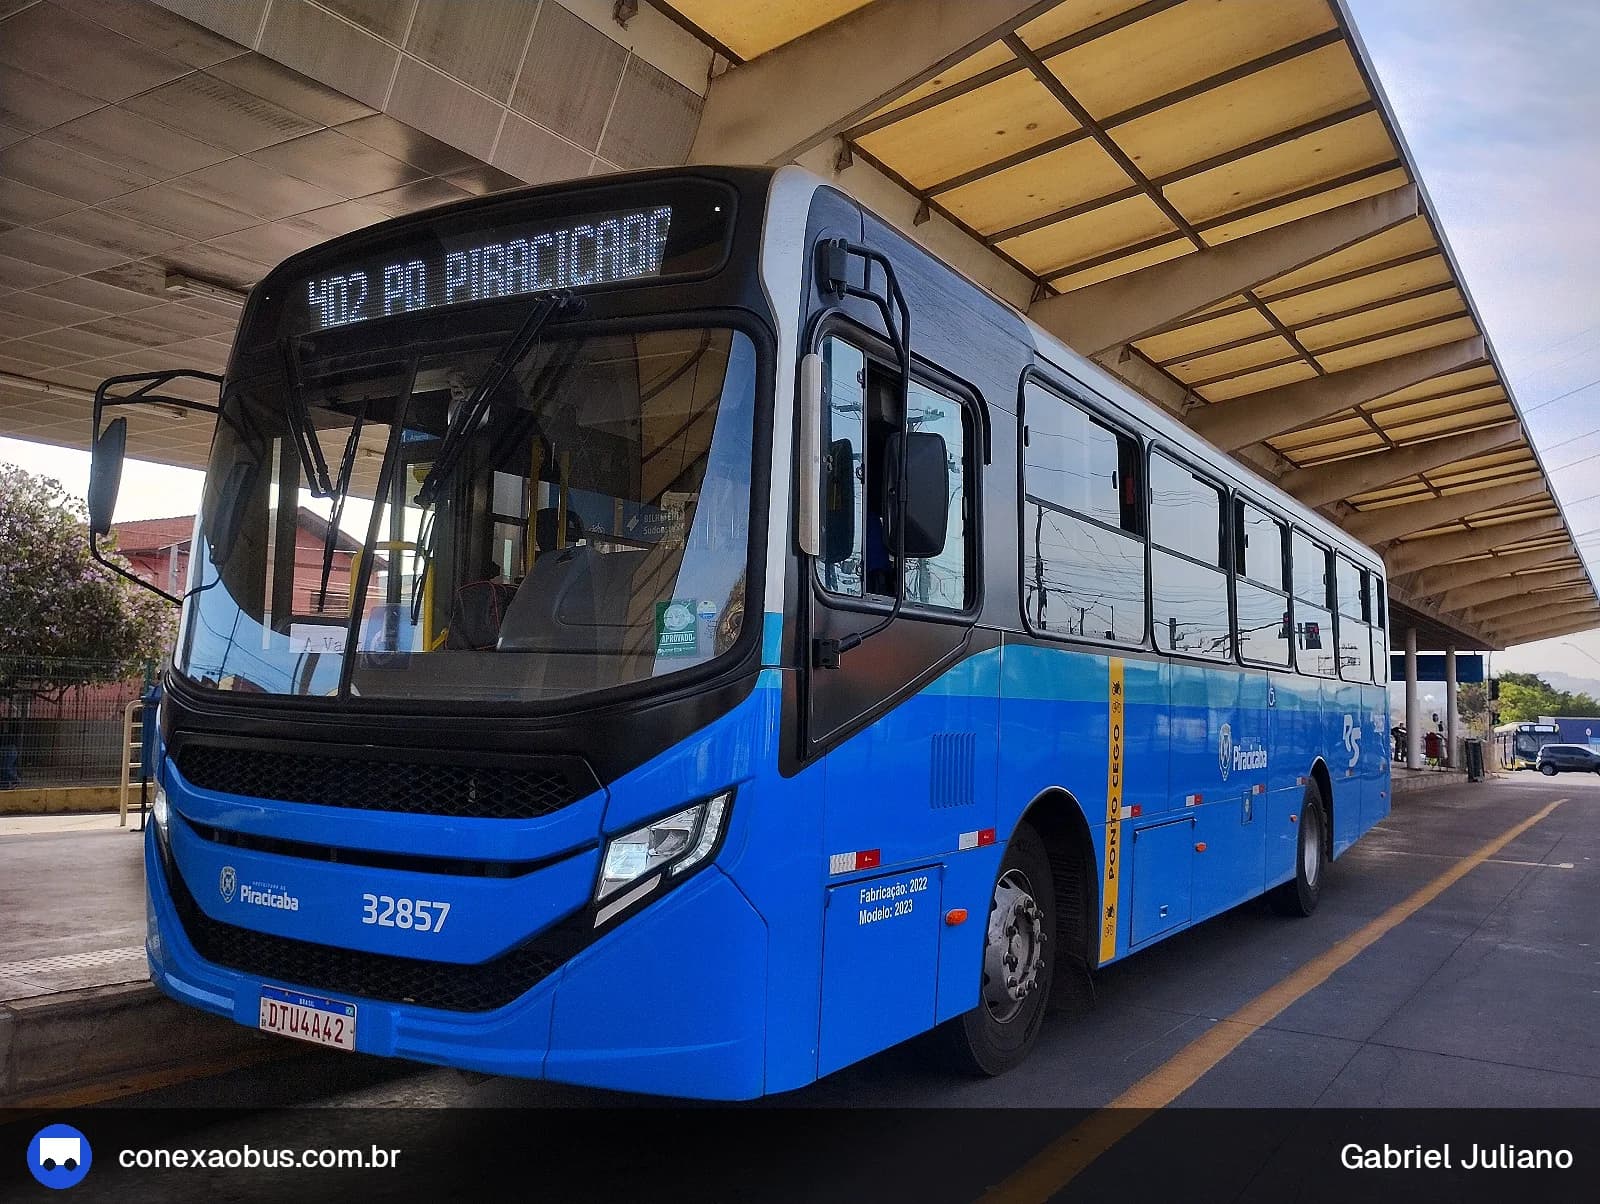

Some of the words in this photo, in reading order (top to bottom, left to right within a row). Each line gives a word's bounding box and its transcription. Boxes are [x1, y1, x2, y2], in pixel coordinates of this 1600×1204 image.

[308, 271, 368, 327] 402
[1112, 724, 1120, 787] CEGO
[1232, 744, 1267, 771] Piracicaba
[1108, 796, 1119, 880] PONTO
[240, 884, 299, 911] Piracicaba
[860, 882, 908, 904] Fabricação:
[909, 876, 928, 893] 2022
[362, 894, 450, 932] 32857
[859, 905, 893, 926] Modelo:
[894, 899, 914, 917] 2023
[268, 1003, 344, 1044] DTU4A42
